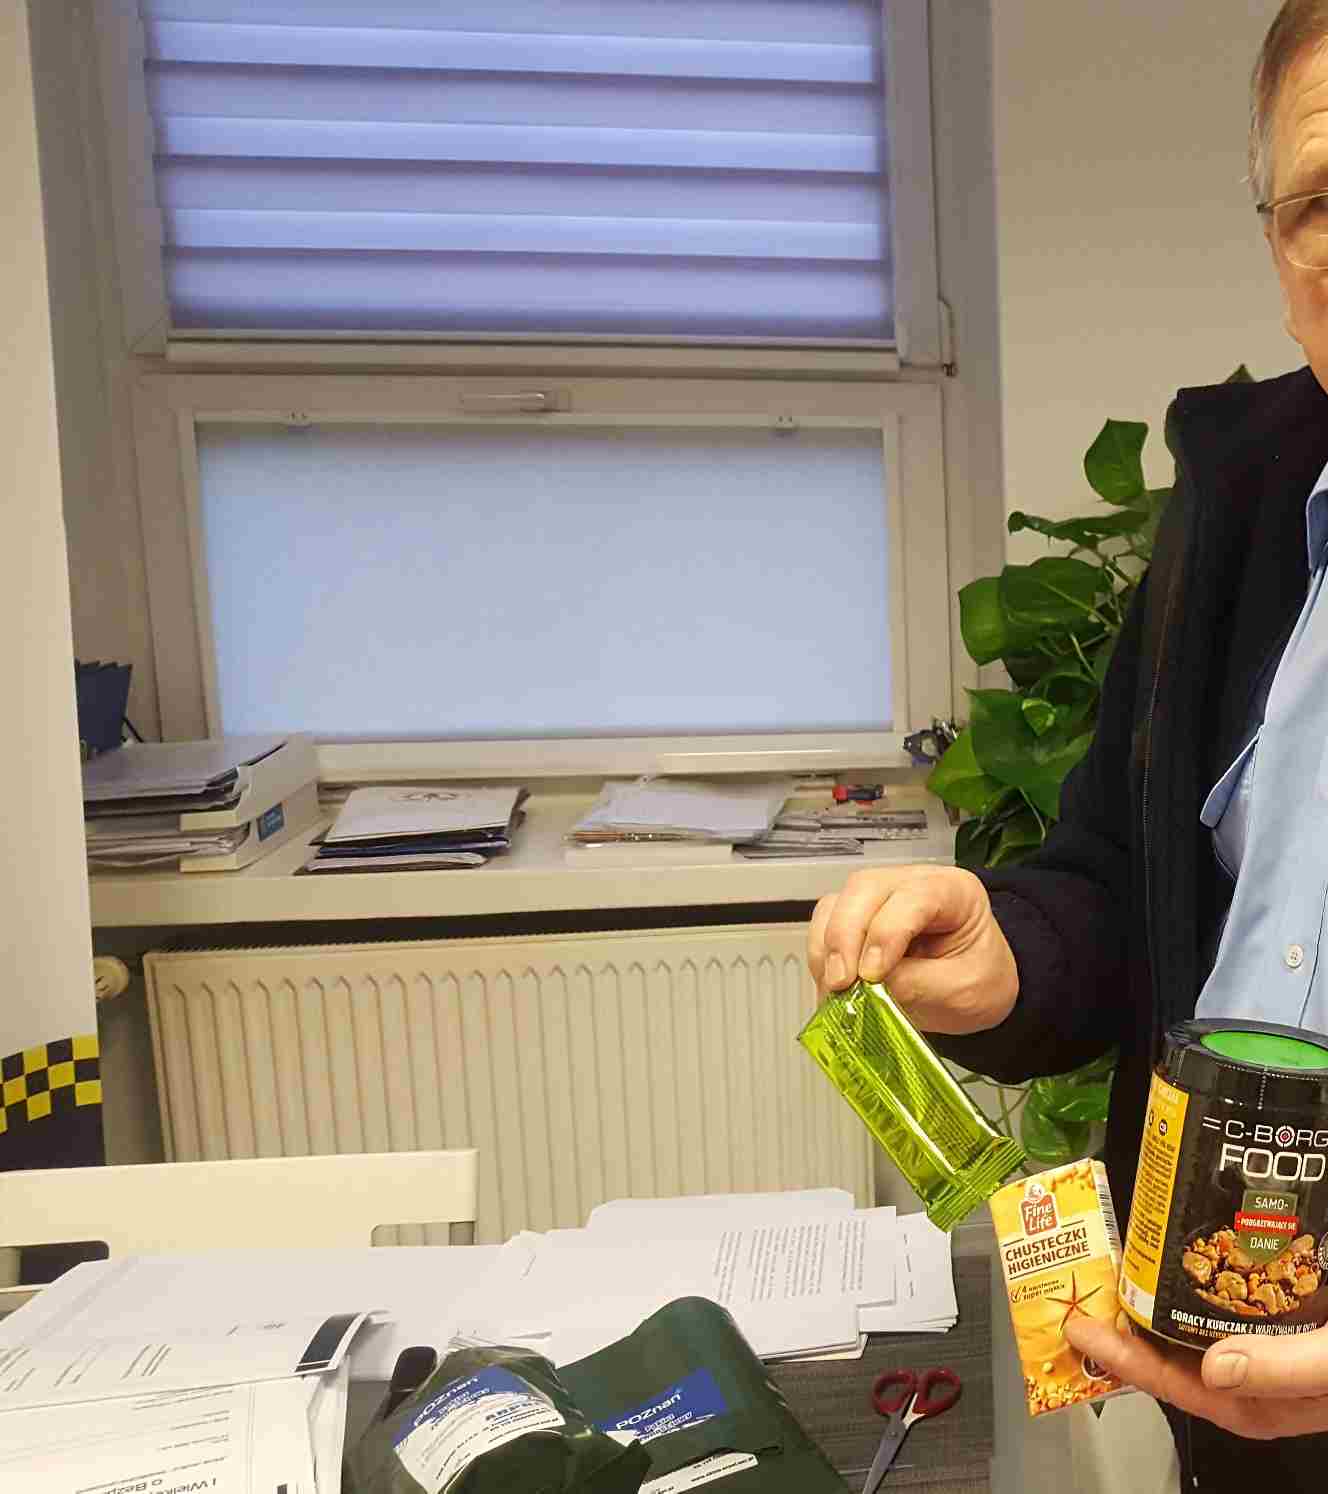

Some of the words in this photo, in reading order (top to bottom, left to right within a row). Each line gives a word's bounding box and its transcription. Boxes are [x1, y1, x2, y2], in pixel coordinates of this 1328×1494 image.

[1219, 1142, 1327, 1182] FOOD
[1024, 1202, 1055, 1218] Fine
[1029, 1216, 1055, 1231] Life
[1005, 1227, 1088, 1262] CHUSTECZKI
[1249, 1237, 1280, 1250] DANIE
[1007, 1240, 1090, 1275] HIGIENICZNE
[1206, 1317, 1248, 1334] KURCZAK
